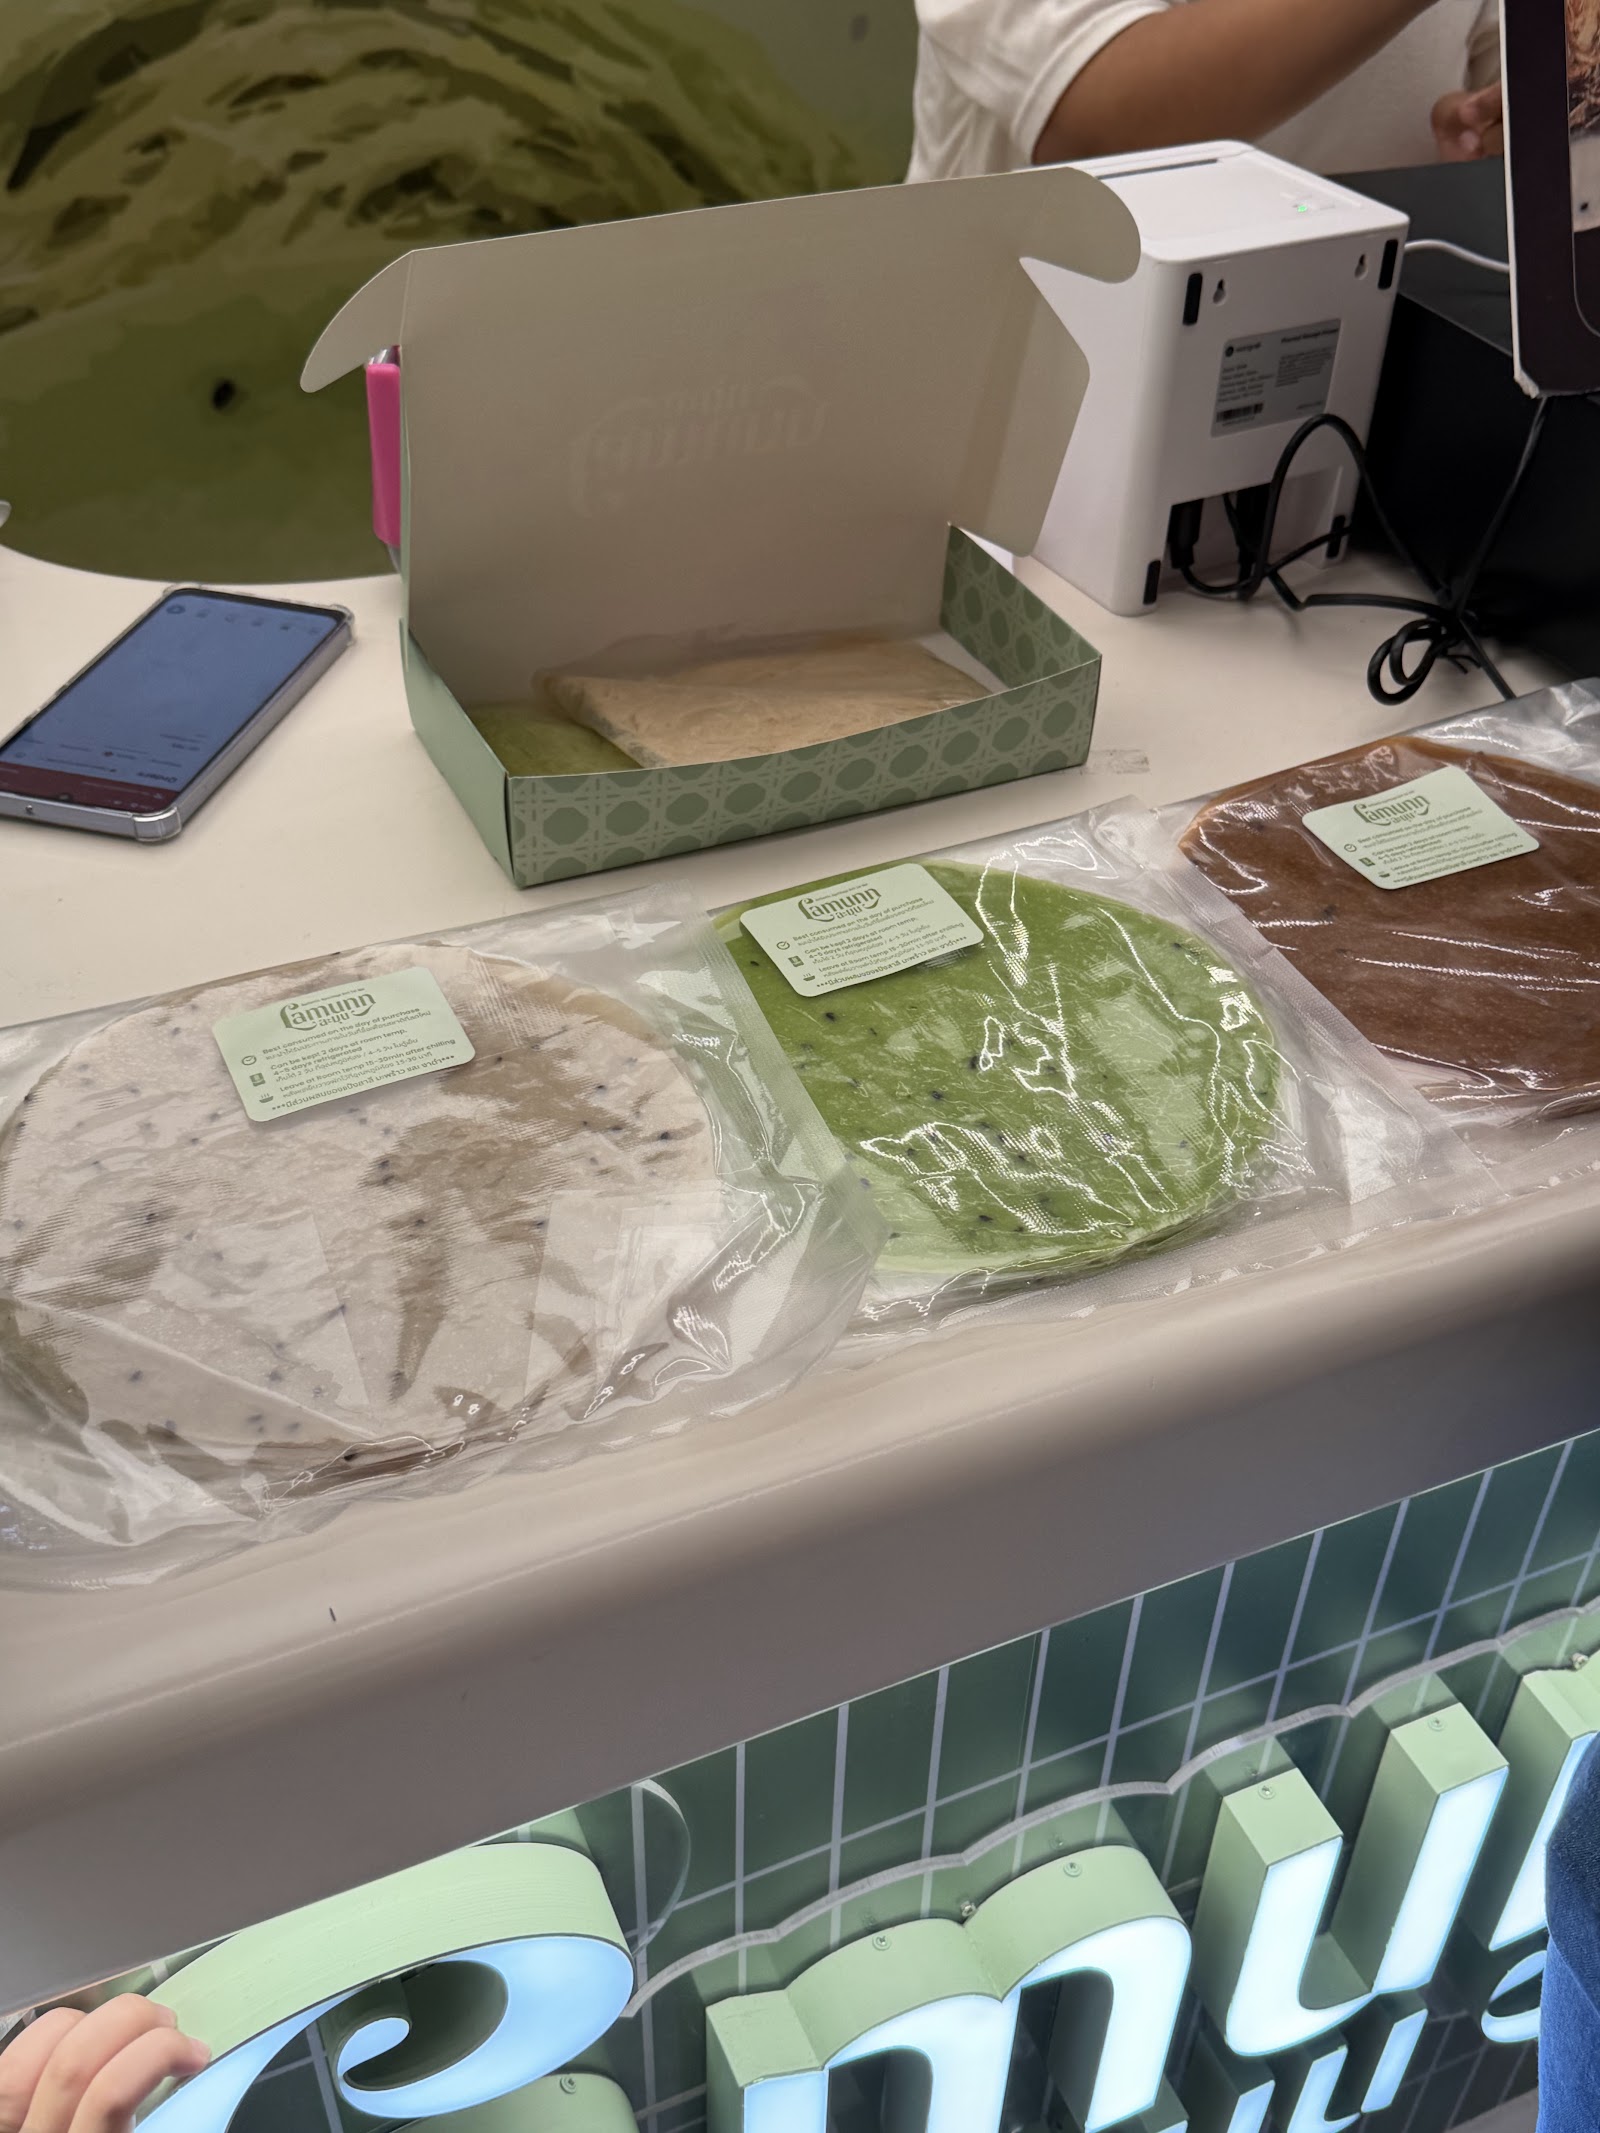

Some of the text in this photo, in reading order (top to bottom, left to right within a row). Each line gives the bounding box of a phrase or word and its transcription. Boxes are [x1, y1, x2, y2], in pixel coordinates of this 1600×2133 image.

[1353, 795, 1430, 826] Lamunn
[798, 887, 882, 922] Lamunn
[280, 992, 376, 1031] Lamunn
[262, 1045, 281, 1054] Best
[282, 1031, 326, 1048] consumed
[354, 1020, 370, 1028] day
[381, 1008, 420, 1022] purchase
[270, 1062, 288, 1070] Can
[301, 1051, 320, 1061] kept
[328, 1044, 348, 1053] days
[359, 1035, 382, 1044] room
[279, 1081, 305, 1092] Leave
[315, 1070, 341, 1081] Room
[341, 1063, 365, 1073] temp
[405, 1046, 424, 1056] after
[425, 1039, 456, 1052] chilling
[291, 1061, 312, 1071] days
[313, 1046, 362, 1064] refrigerated
